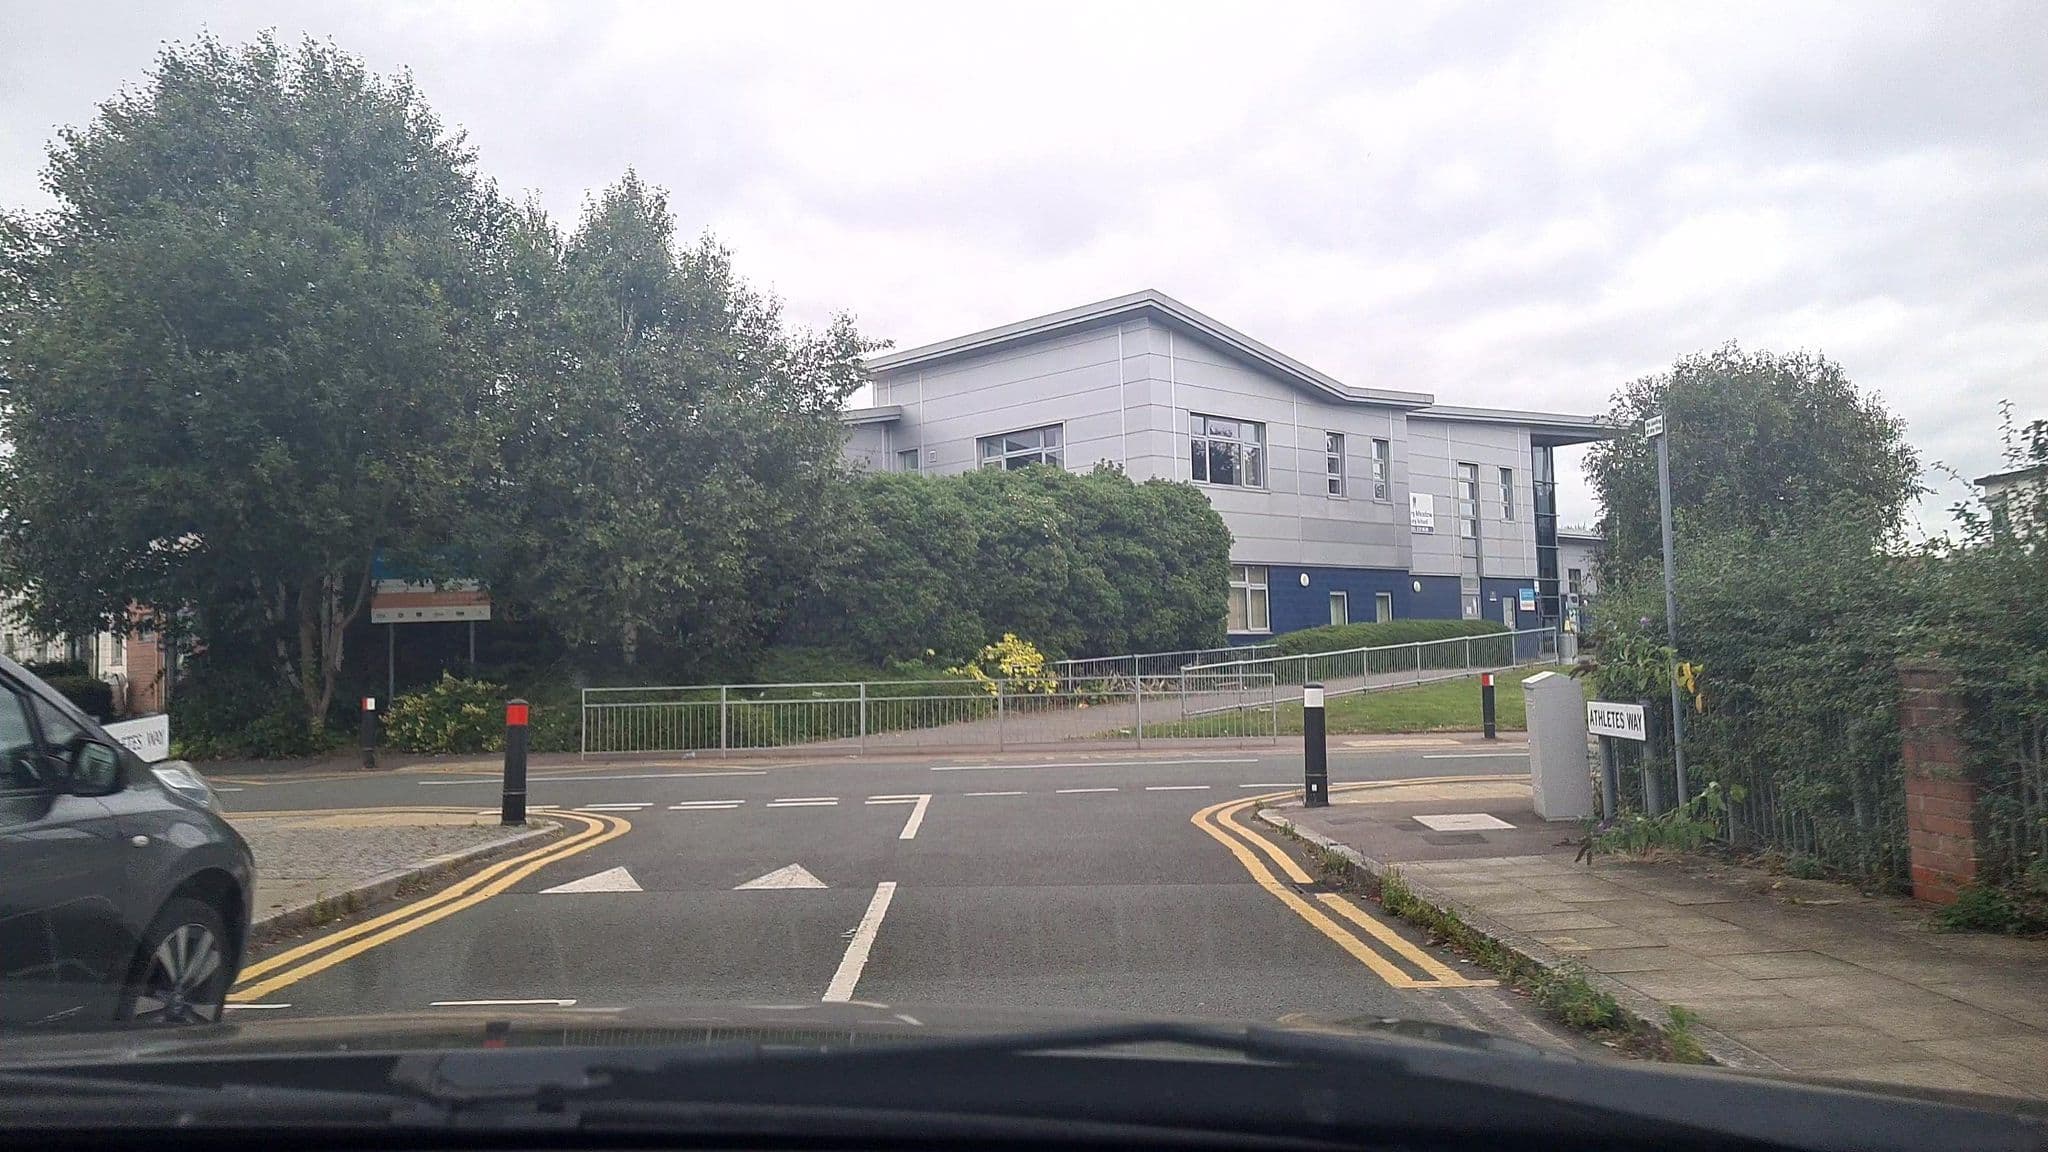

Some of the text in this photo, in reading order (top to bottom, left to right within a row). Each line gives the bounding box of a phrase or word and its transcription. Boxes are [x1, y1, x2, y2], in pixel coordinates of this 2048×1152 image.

[1590, 709, 1642, 731] ATHLETES WAY
[147, 729, 163, 746] WAY
